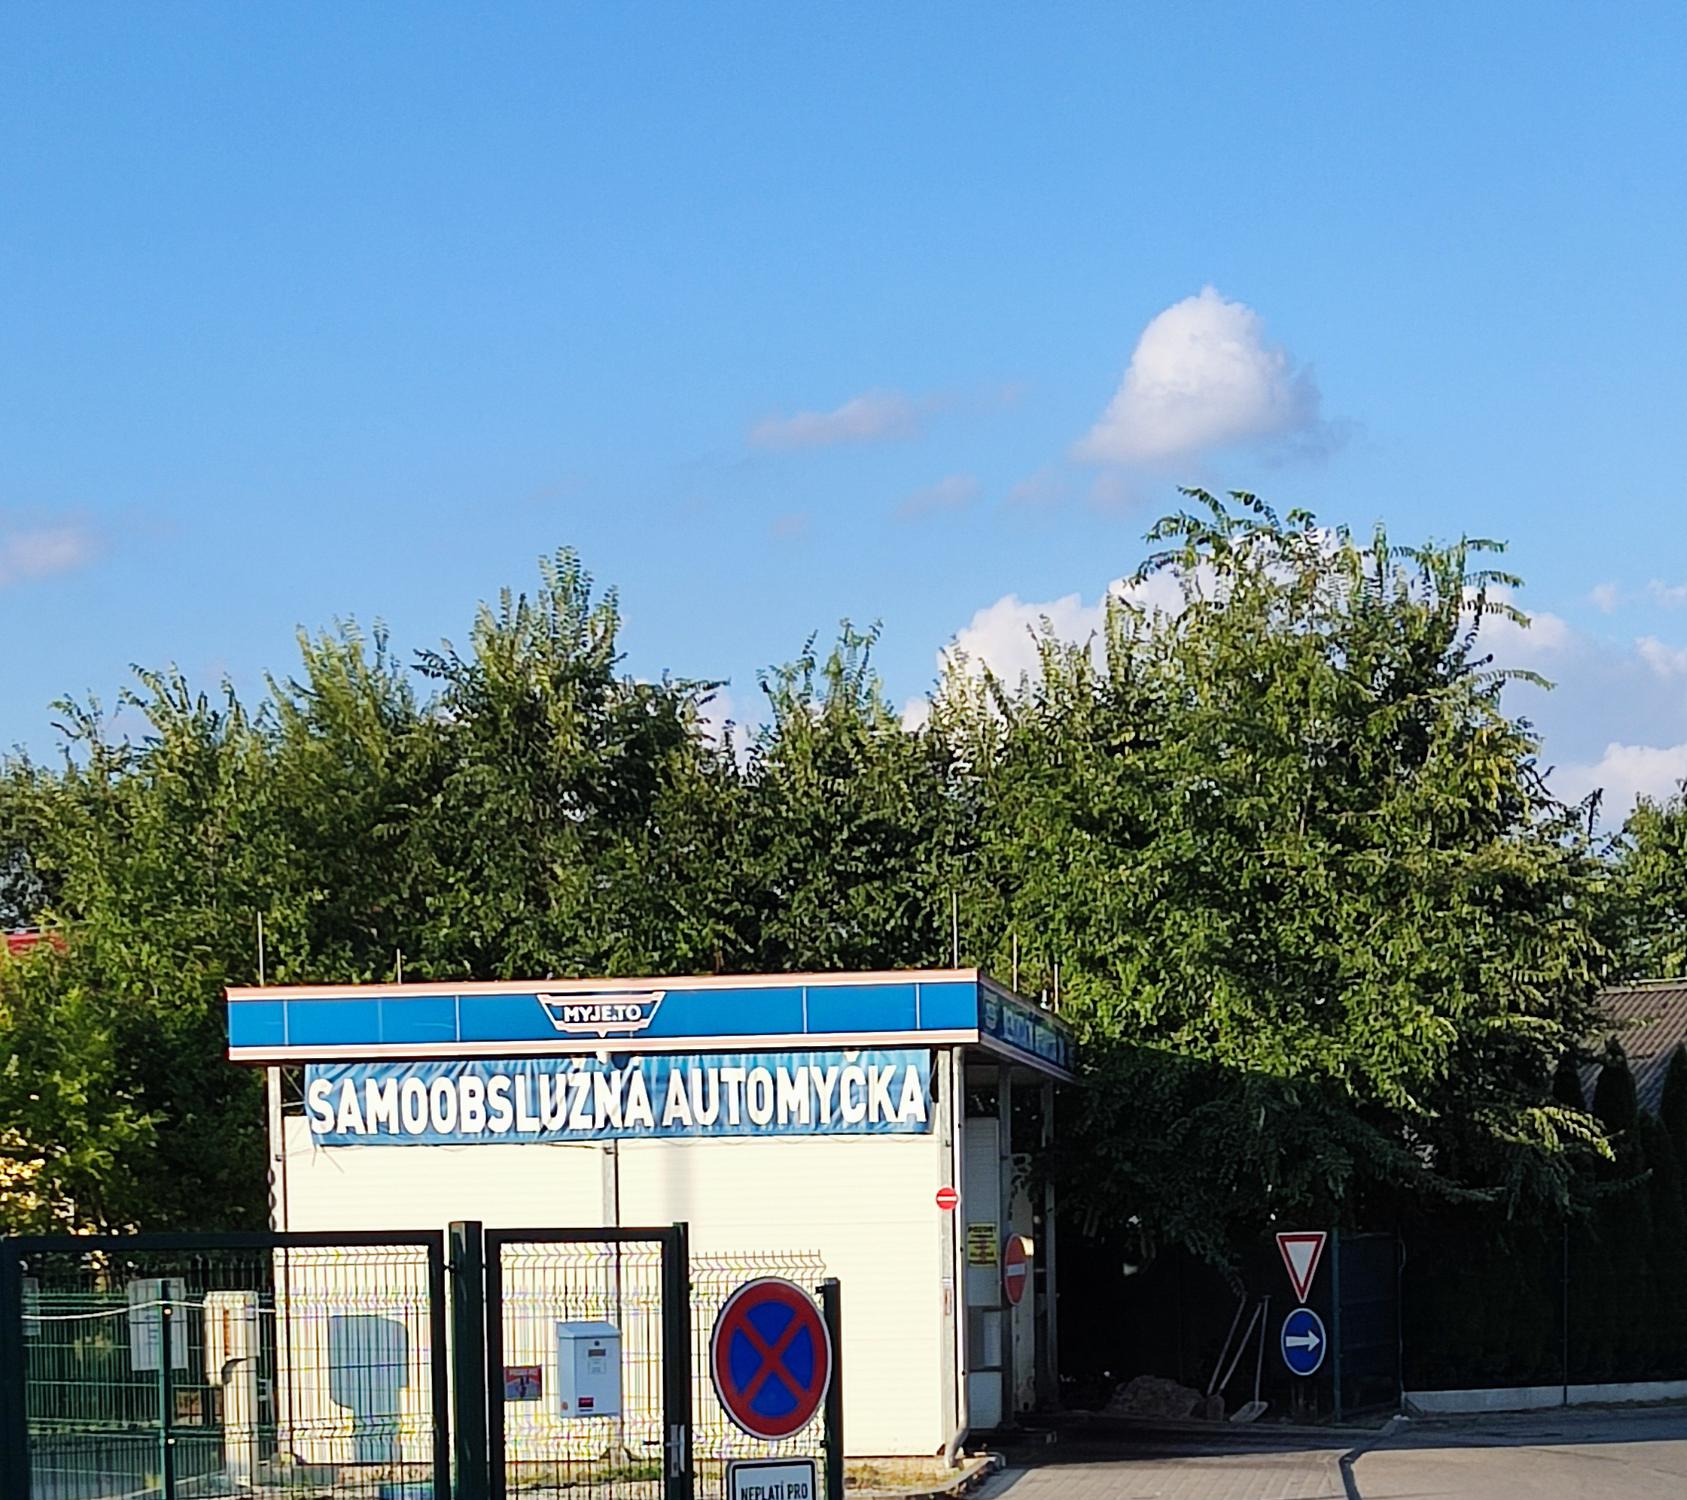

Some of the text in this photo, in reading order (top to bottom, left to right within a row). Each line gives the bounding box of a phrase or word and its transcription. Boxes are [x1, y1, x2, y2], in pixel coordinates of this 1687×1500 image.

[563, 1004, 642, 1023] MYJE.TO
[308, 1051, 927, 1135] SAMOOBSLUŽNÁ AUTOMYČKA
[787, 1483, 807, 1499] PRO
